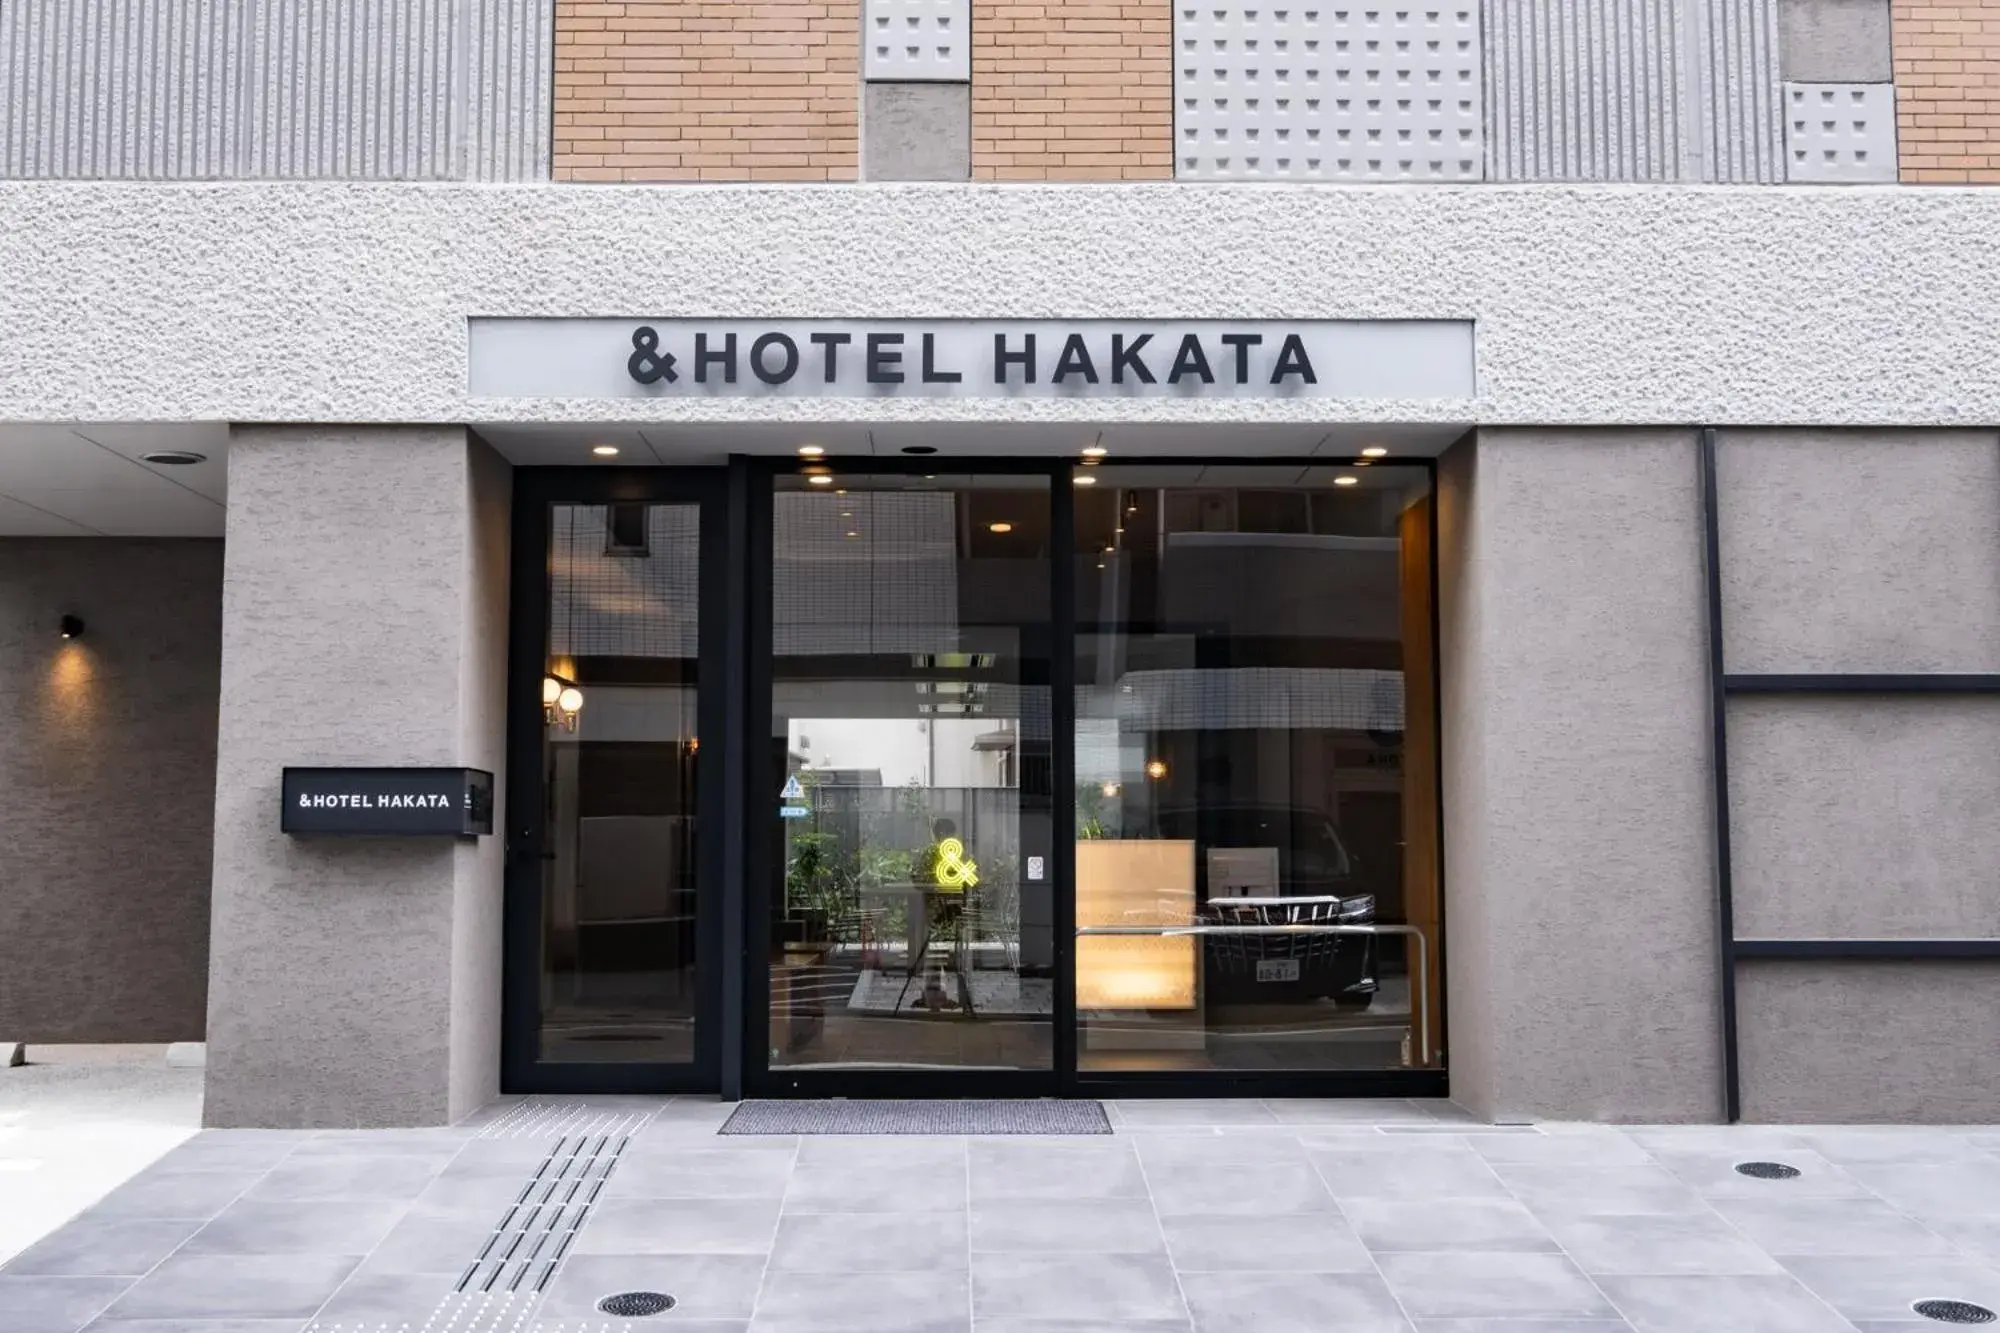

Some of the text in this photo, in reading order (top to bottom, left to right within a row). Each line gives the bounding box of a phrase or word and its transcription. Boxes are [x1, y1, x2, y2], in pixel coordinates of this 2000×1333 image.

[628, 326, 1317, 385] &HOTEL HAKATA
[299, 794, 450, 808] &HOTEL HAKATA
[934, 838, 979, 888] &
